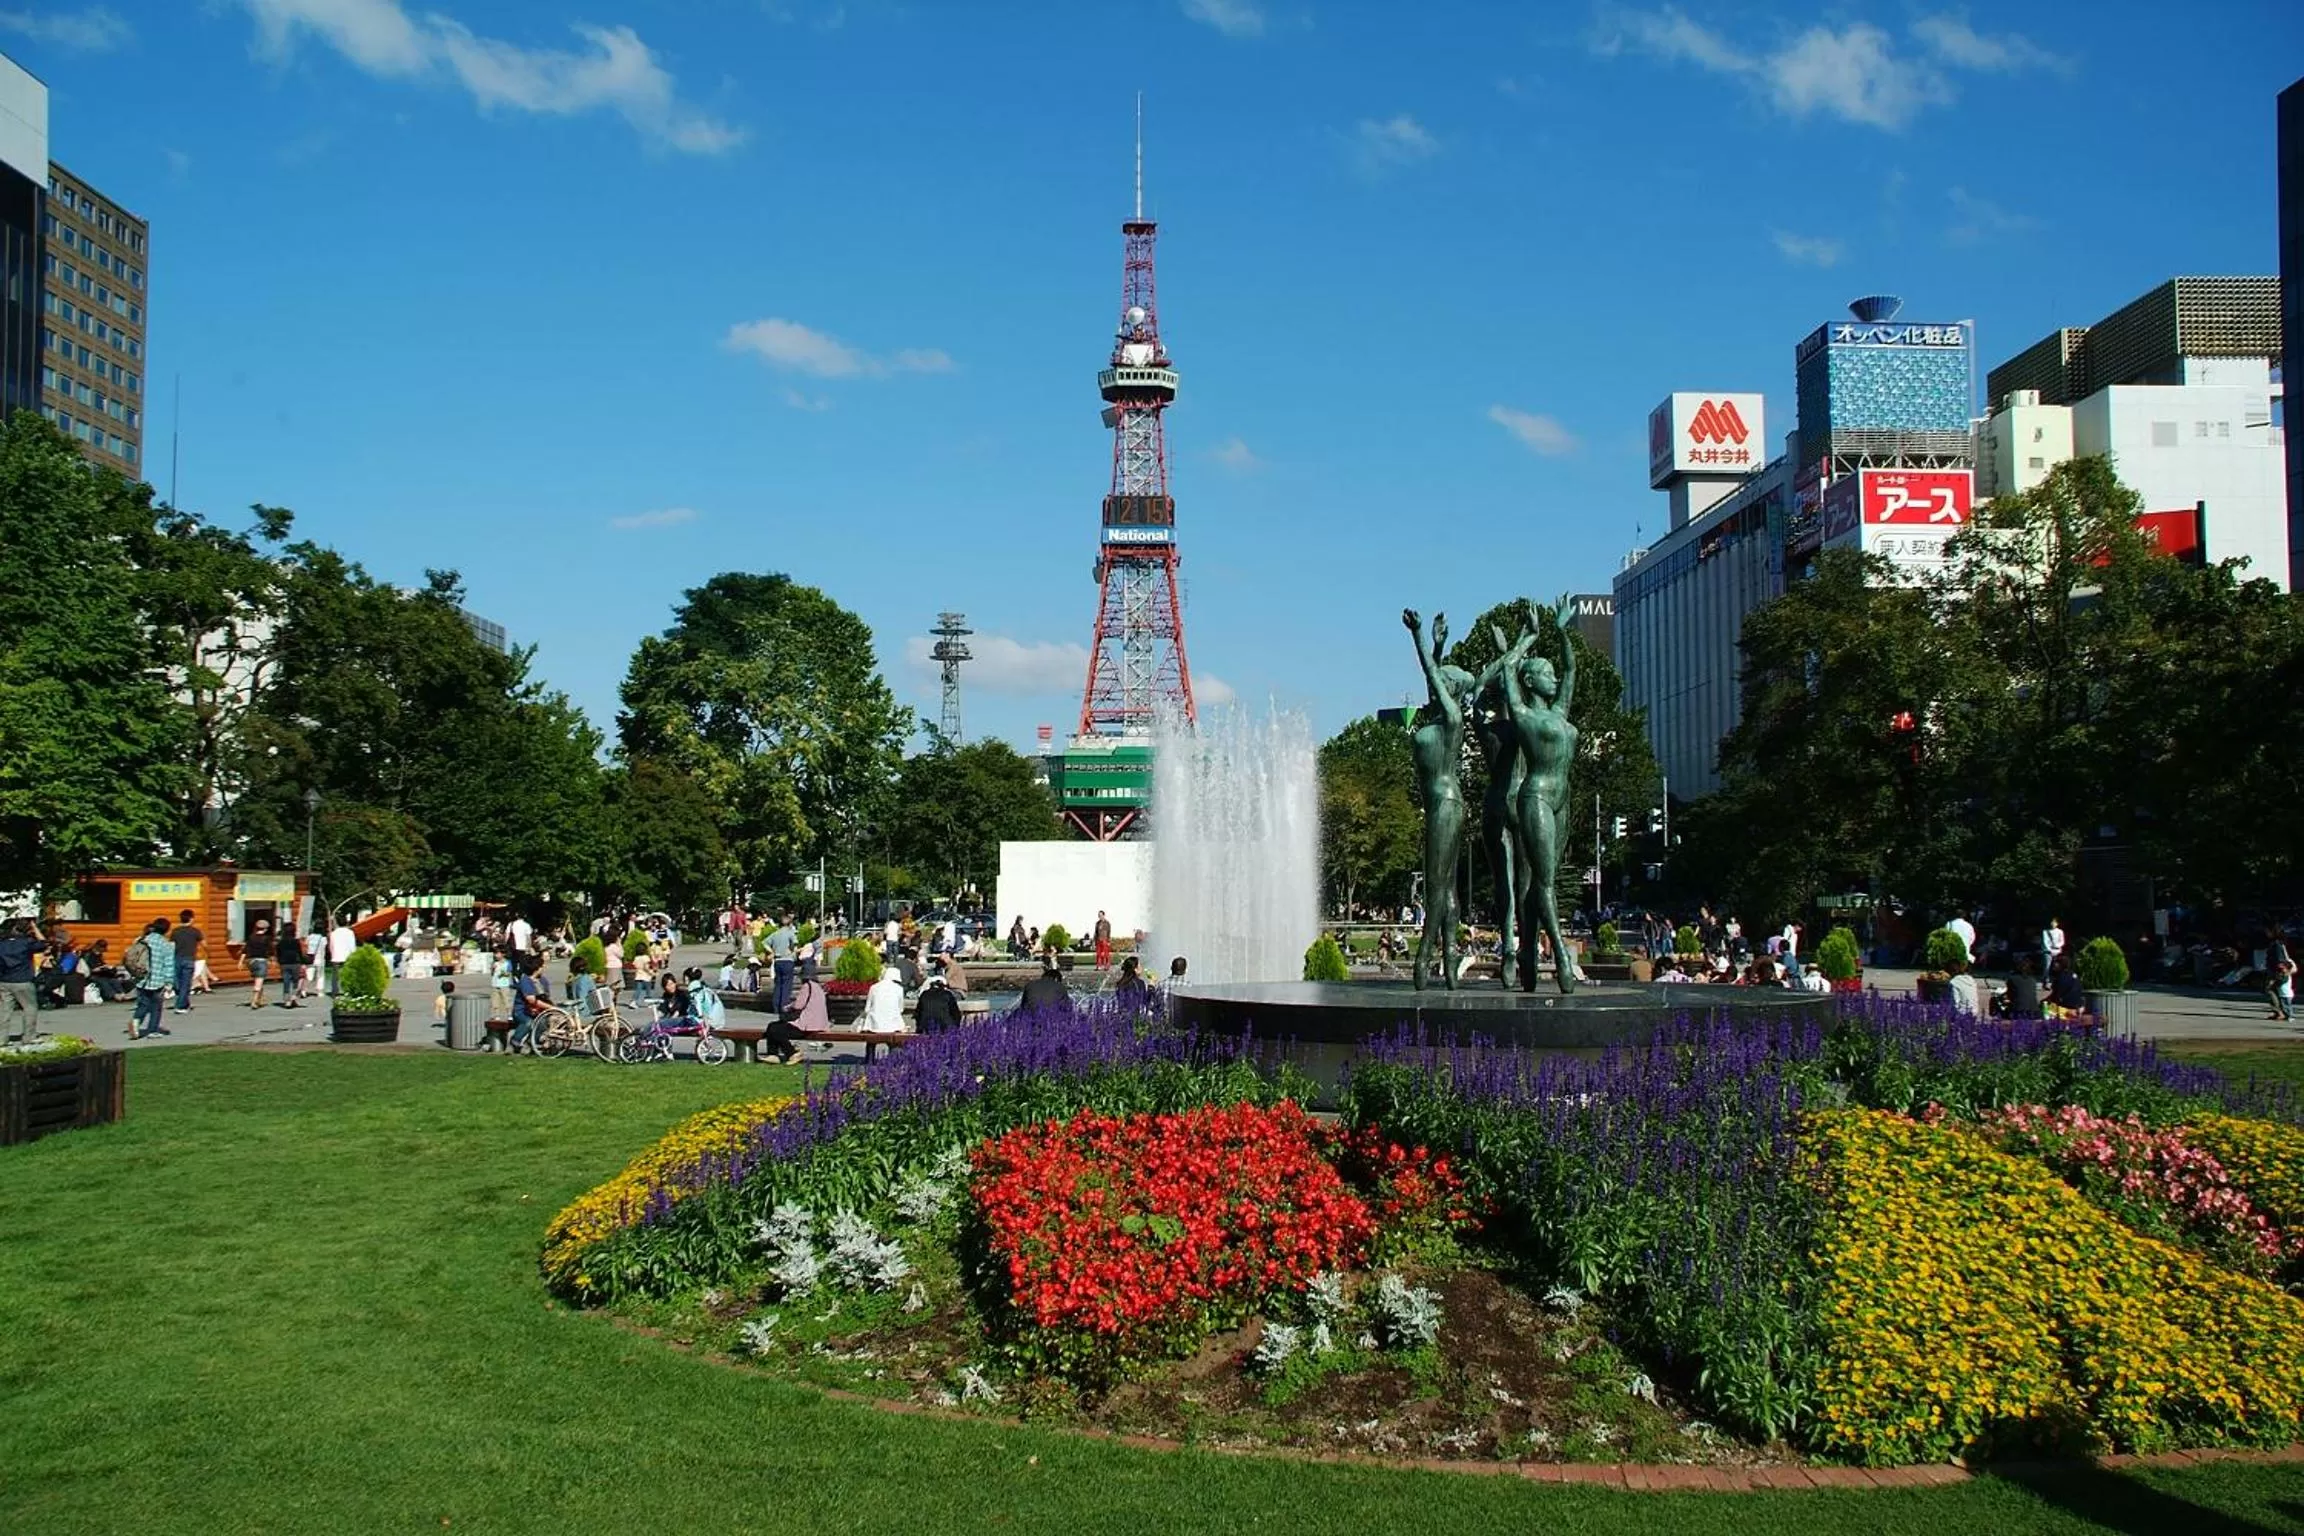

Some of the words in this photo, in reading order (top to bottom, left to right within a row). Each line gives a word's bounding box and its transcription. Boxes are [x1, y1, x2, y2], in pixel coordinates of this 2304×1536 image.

[1835, 325, 1963, 344] オッペン化粧品
[1688, 448, 1750, 464] 丸井今井
[1876, 487, 1963, 523] アース
[1108, 528, 1169, 541] National
[1880, 539, 1941, 556] 無人契約
